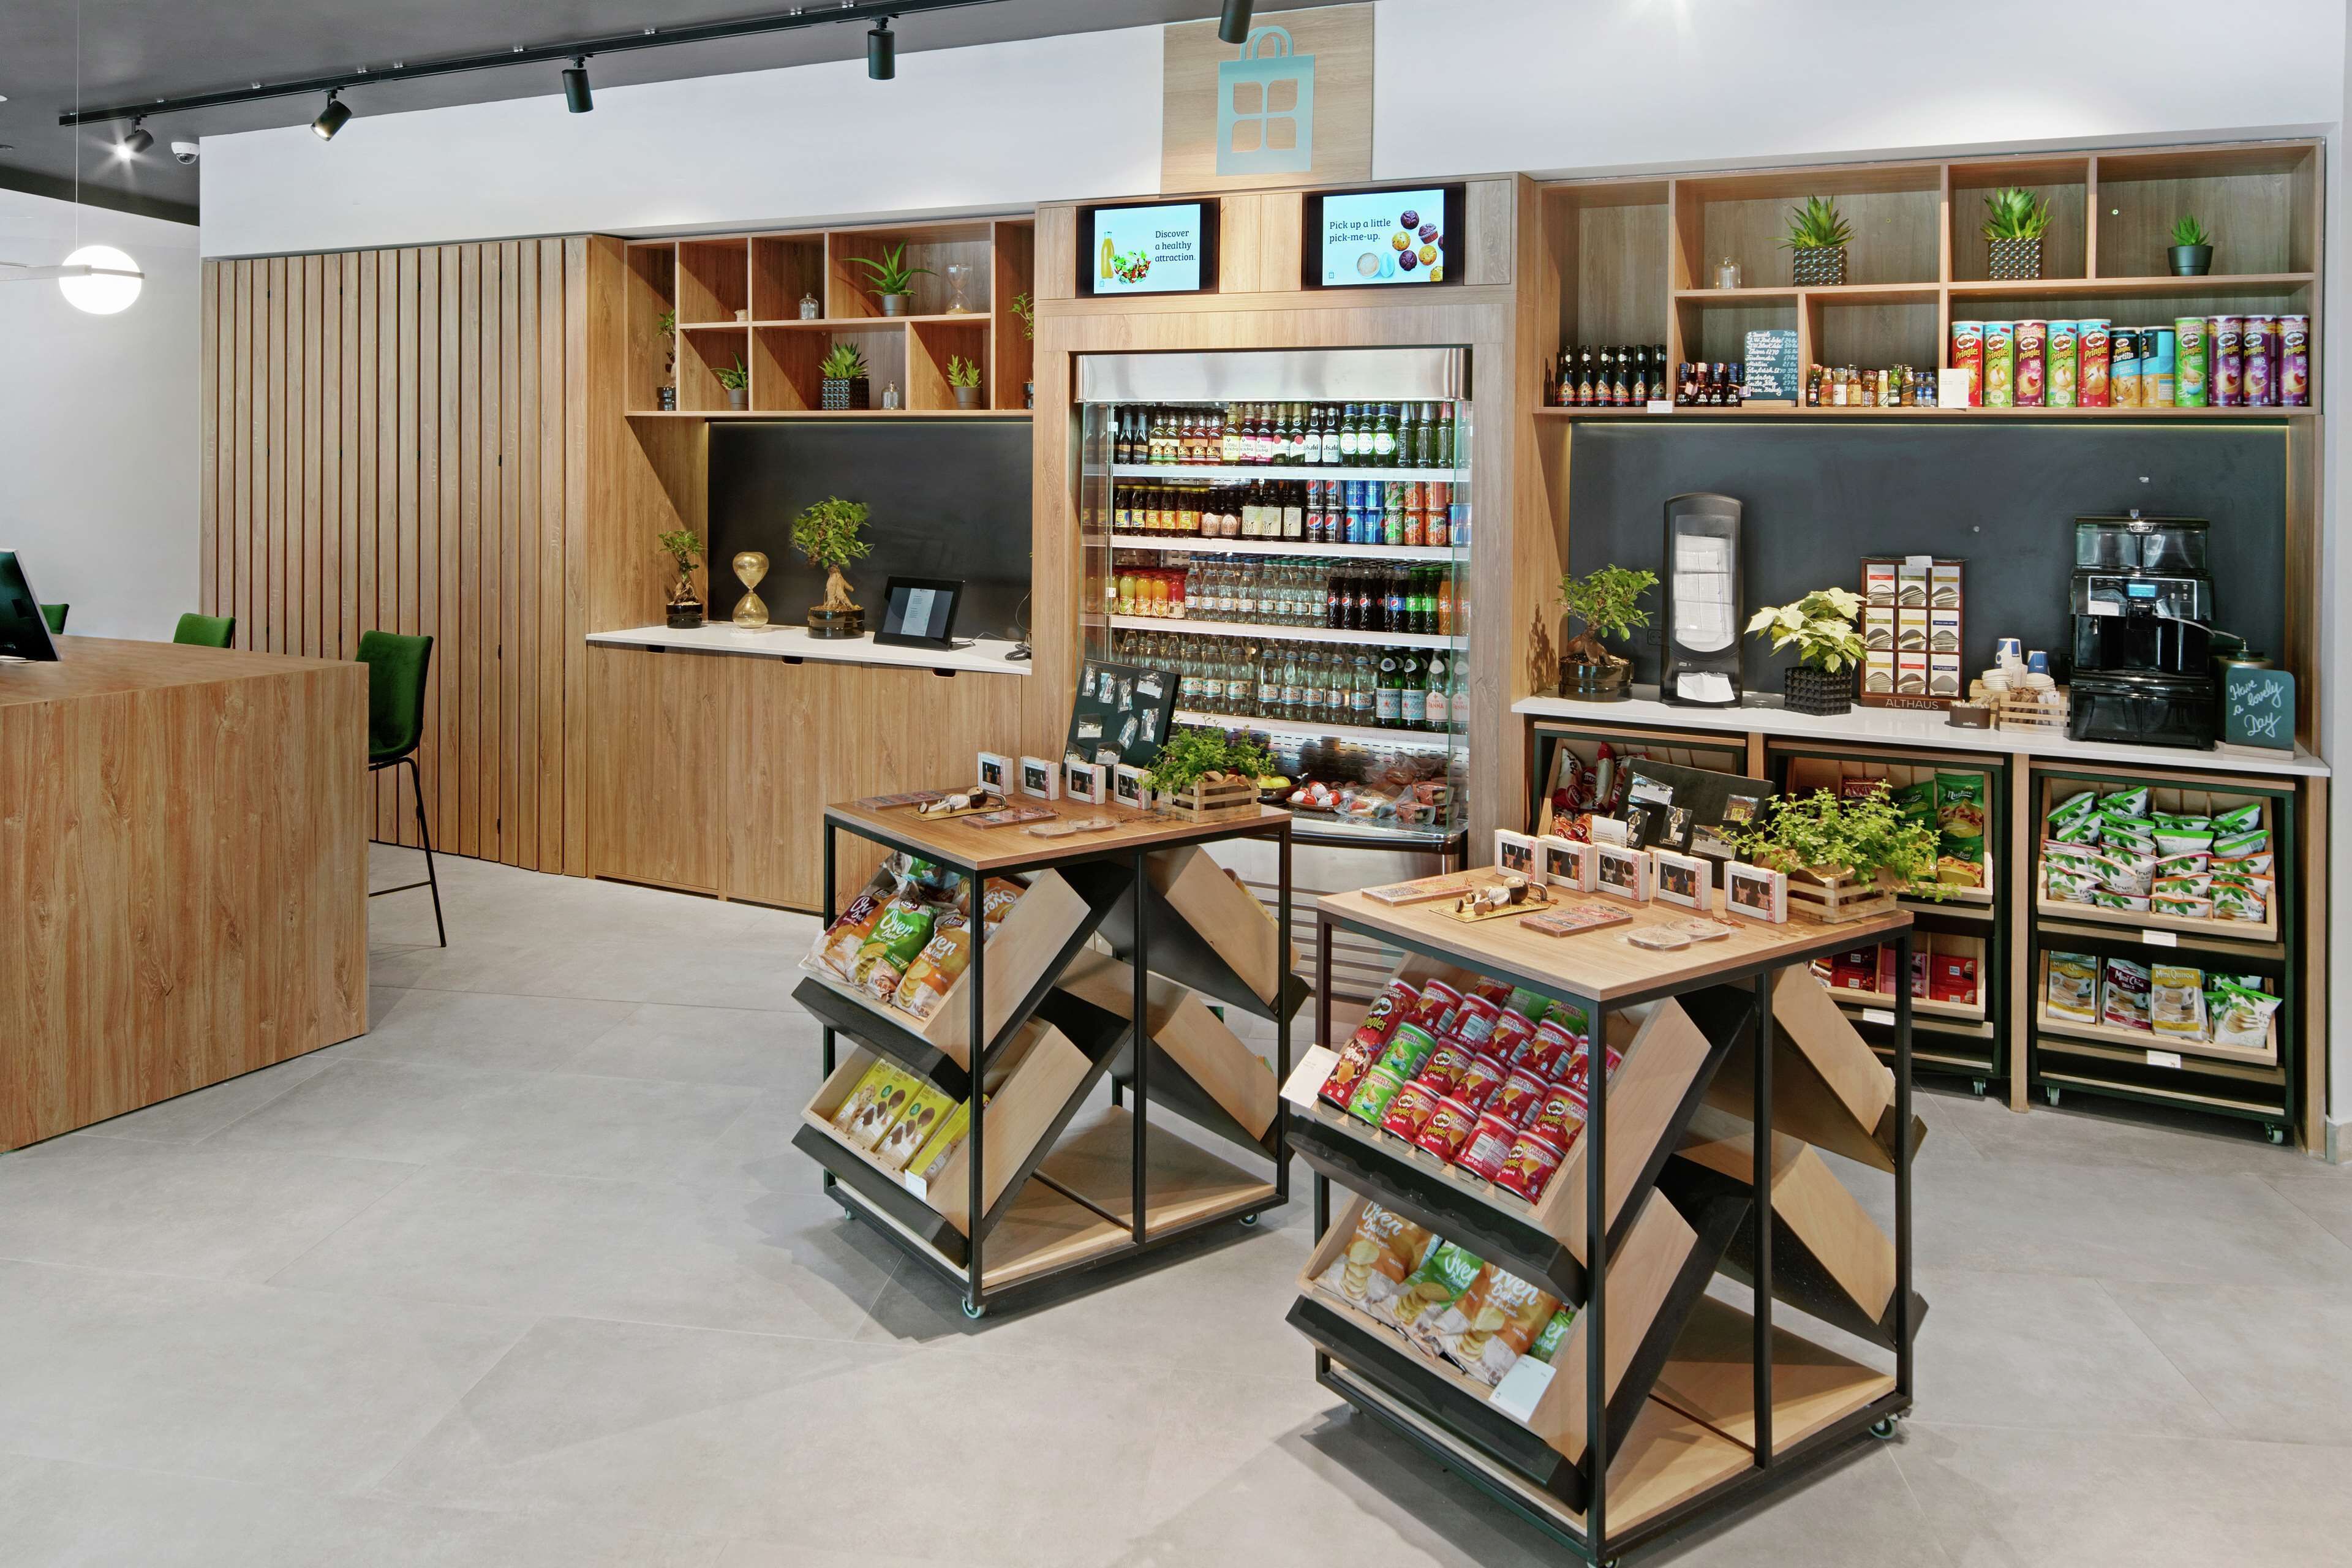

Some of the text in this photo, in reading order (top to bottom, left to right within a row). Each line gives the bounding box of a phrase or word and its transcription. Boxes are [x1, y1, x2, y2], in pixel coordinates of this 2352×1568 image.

[1329, 221, 1348, 229] Pick
[1350, 221, 1361, 230] up
[1371, 219, 1391, 227] little
[1329, 233, 1381, 244] pick-me-up.
[1161, 241, 1192, 251] healthy
[1155, 253, 1196, 262] attraction.
[1956, 347, 1978, 362] Pringles
[1986, 348, 2009, 364] Pringles
[2019, 349, 2041, 362] Pringles
[2051, 349, 2074, 365] Pringles
[2084, 345, 2108, 361] Pringles
[2180, 346, 2203, 359] Pringles
[2217, 345, 2239, 359] Pringles
[2283, 344, 2306, 358] Pringles
[2230, 680, 2258, 701] Have
[2248, 679, 2283, 708] lovely
[1885, 699, 1939, 709] ALTHAUS
[2244, 712, 2282, 738] Day
[880, 909, 914, 938] Oven
[930, 933, 958, 957] ven
[2114, 971, 2144, 988] Mini Chia
[2155, 970, 2195, 980] Mini Quinoa
[1426, 1064, 1449, 1076] Pringles
[1429, 1072, 1444, 1082] Original
[1392, 1115, 1407, 1125] Original
[1538, 1113, 1562, 1126] Pringles
[1424, 1125, 1447, 1138] Pringles
[1541, 1123, 1559, 1134] Original
[1427, 1134, 1442, 1145] Original
[1531, 1145, 1552, 1161] PERFECT
